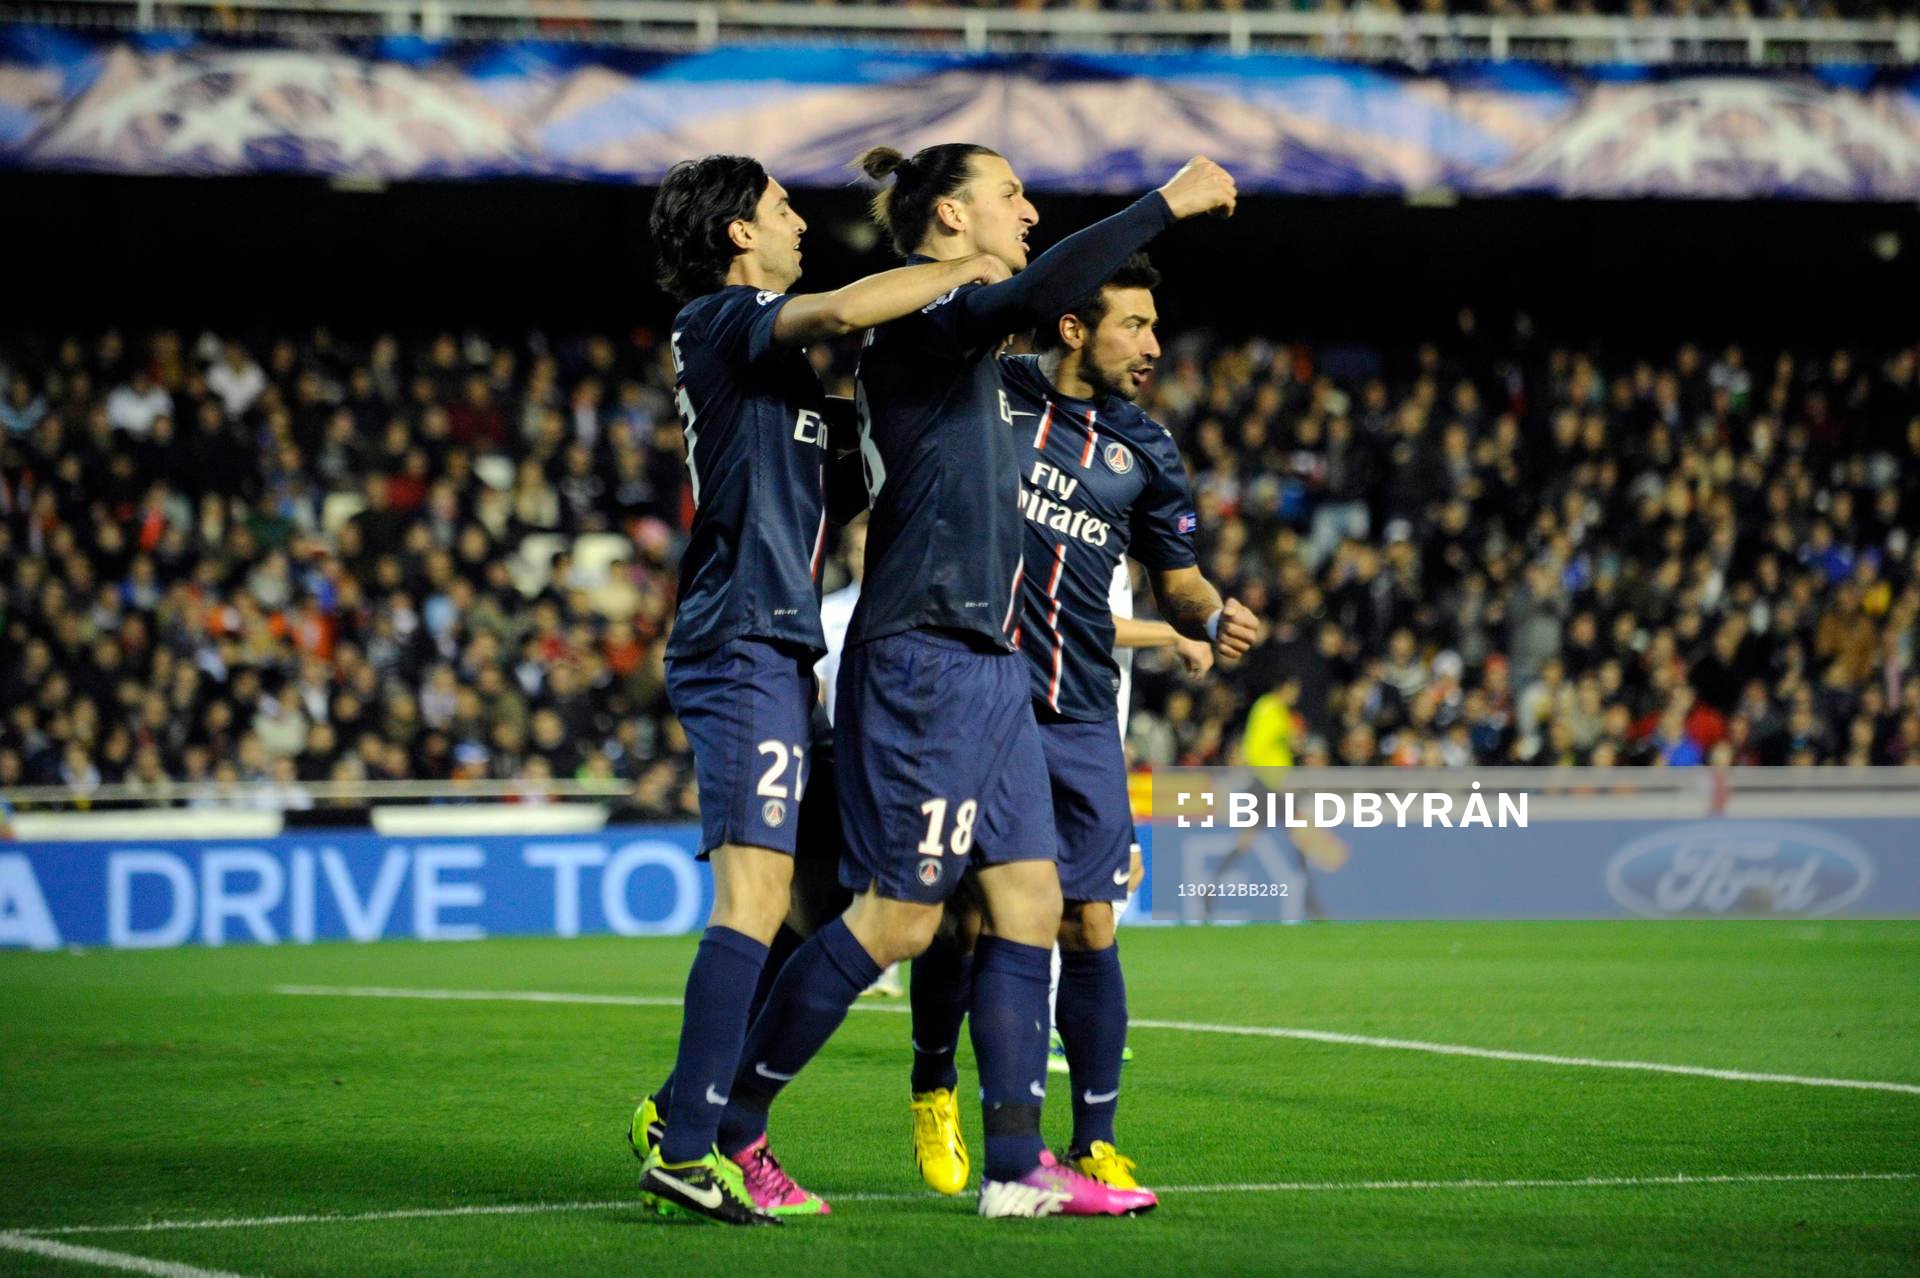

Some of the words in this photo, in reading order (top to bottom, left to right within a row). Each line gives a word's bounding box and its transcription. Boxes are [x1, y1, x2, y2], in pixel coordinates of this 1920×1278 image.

[1031, 461, 1078, 500] Fly
[1020, 489, 1111, 546] irates
[918, 797, 978, 856] 18
[106, 845, 488, 949] DRIVE
[523, 840, 702, 939] TO
[1655, 837, 1822, 912] Ford
